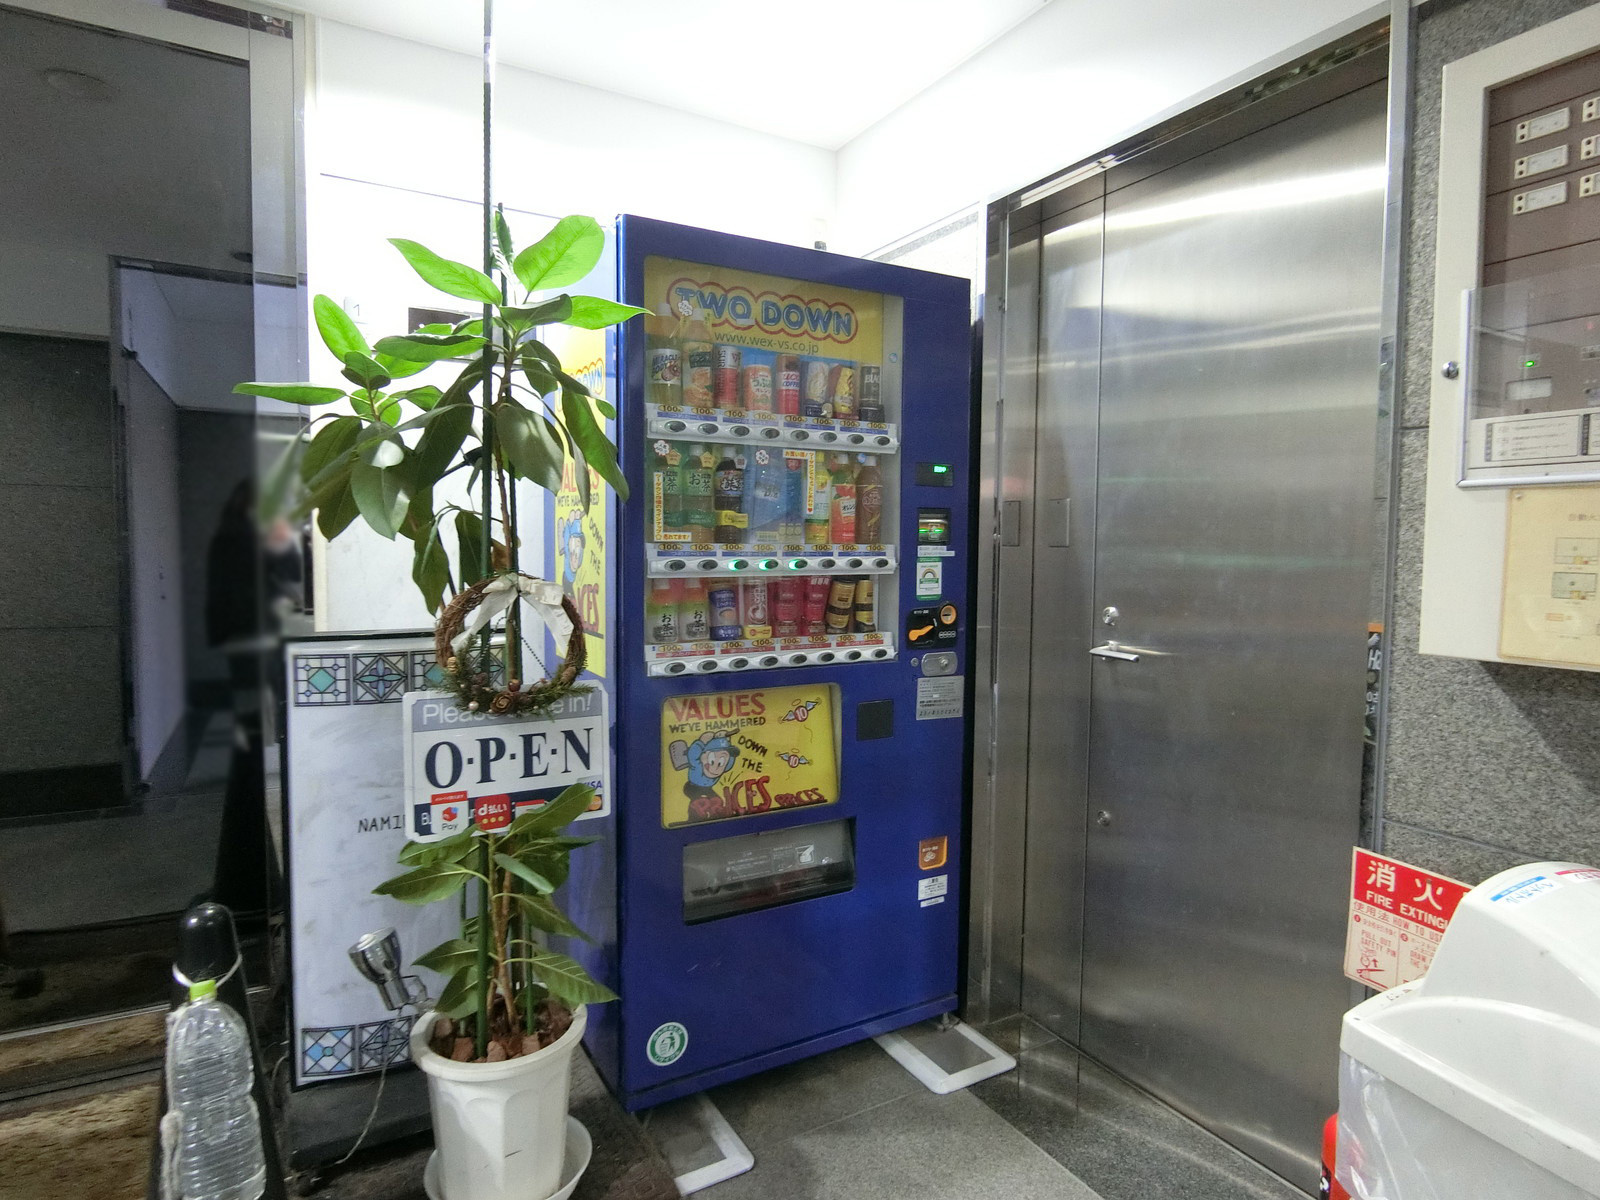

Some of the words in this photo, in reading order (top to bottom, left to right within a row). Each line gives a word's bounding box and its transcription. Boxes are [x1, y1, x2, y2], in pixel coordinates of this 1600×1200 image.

[675, 286, 753, 321] TWO
[761, 299, 852, 337] DOWN
[714, 331, 820, 354] www.wex-vs.co.jp
[422, 701, 498, 726] Plea
[568, 693, 592, 714] in!
[667, 692, 767, 722] VALUES
[669, 720, 702, 734] WE'VE
[705, 716, 767, 732] HAMMERED
[737, 735, 768, 758] DOWN
[741, 757, 763, 773] THE
[358, 815, 405, 833] NAMI
[441, 821, 460, 834] Pay
[1366, 860, 1472, 911] 消火
[1365, 890, 1393, 910] FIRE
[1353, 901, 1390, 923] 使用法
[1393, 916, 1409, 930] HOW
[1415, 923, 1425, 936] TO
[1360, 938, 1383, 952] SAFETY
[1386, 948, 1397, 958] PIN
[1361, 929, 1377, 942] PULL
[1380, 937, 1392, 948] OUT
